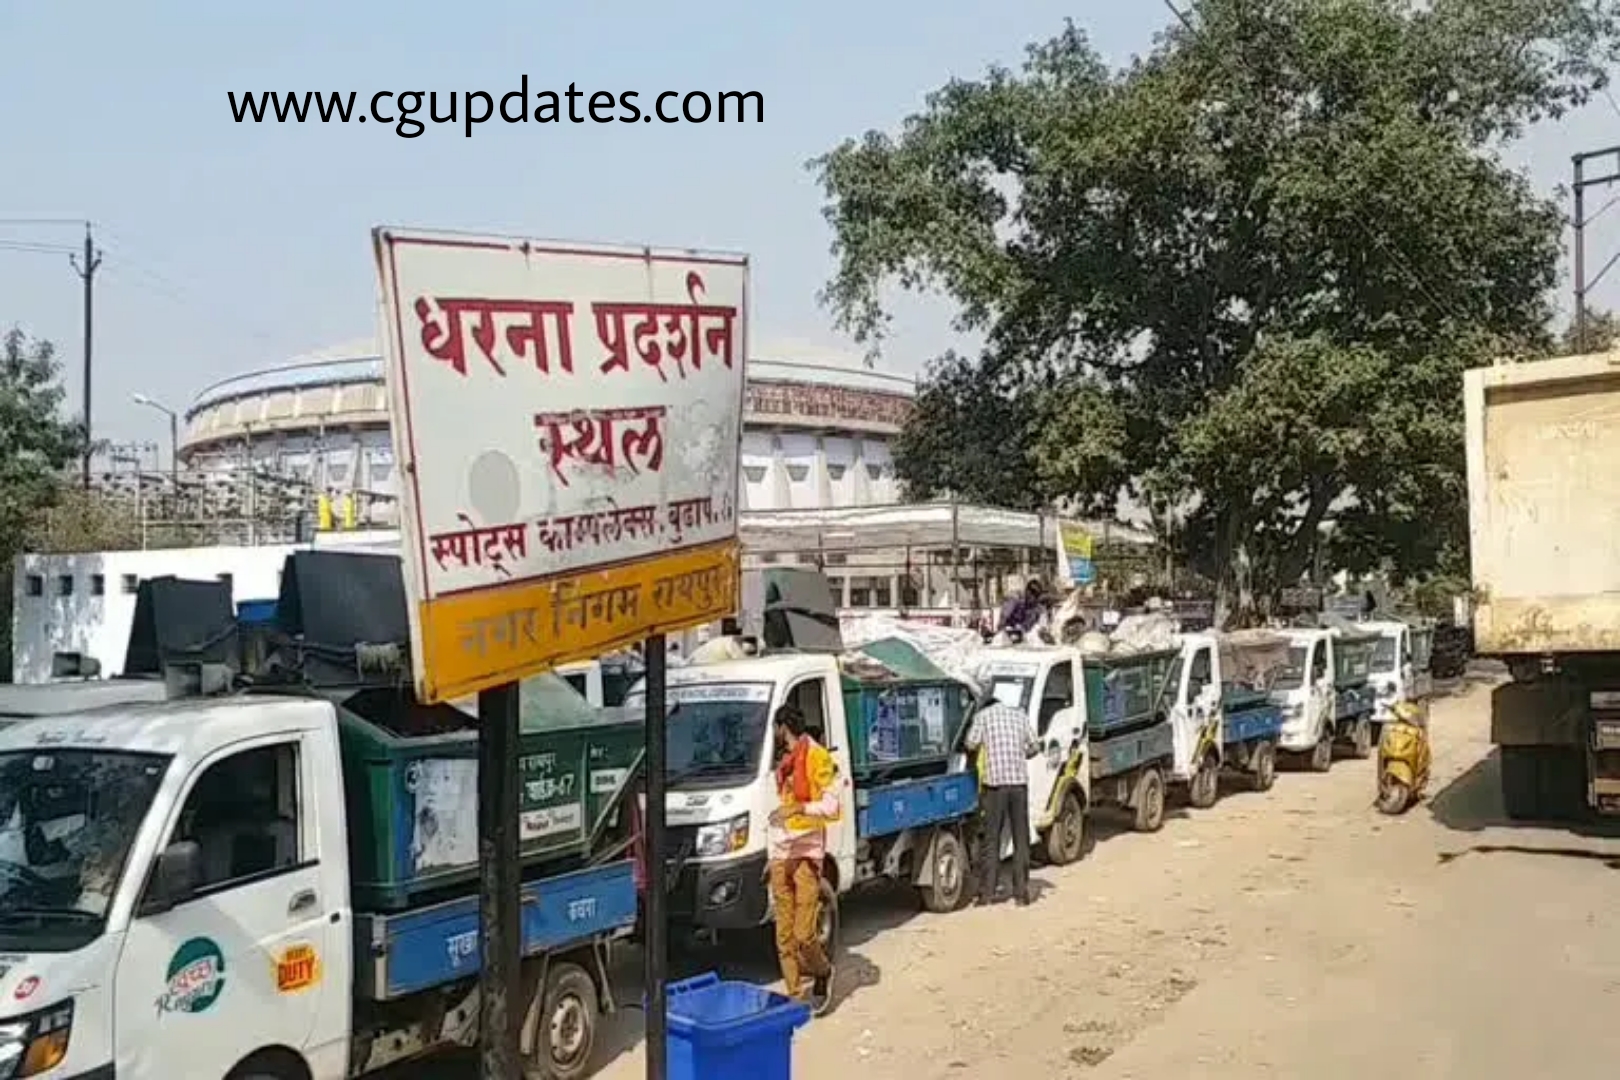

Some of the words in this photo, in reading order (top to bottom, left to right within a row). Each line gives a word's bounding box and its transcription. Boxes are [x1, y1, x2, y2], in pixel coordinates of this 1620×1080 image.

[415, 296, 573, 377] धरना
[592, 271, 737, 382] प्रदर्शन
[533, 406, 667, 486] स्थल
